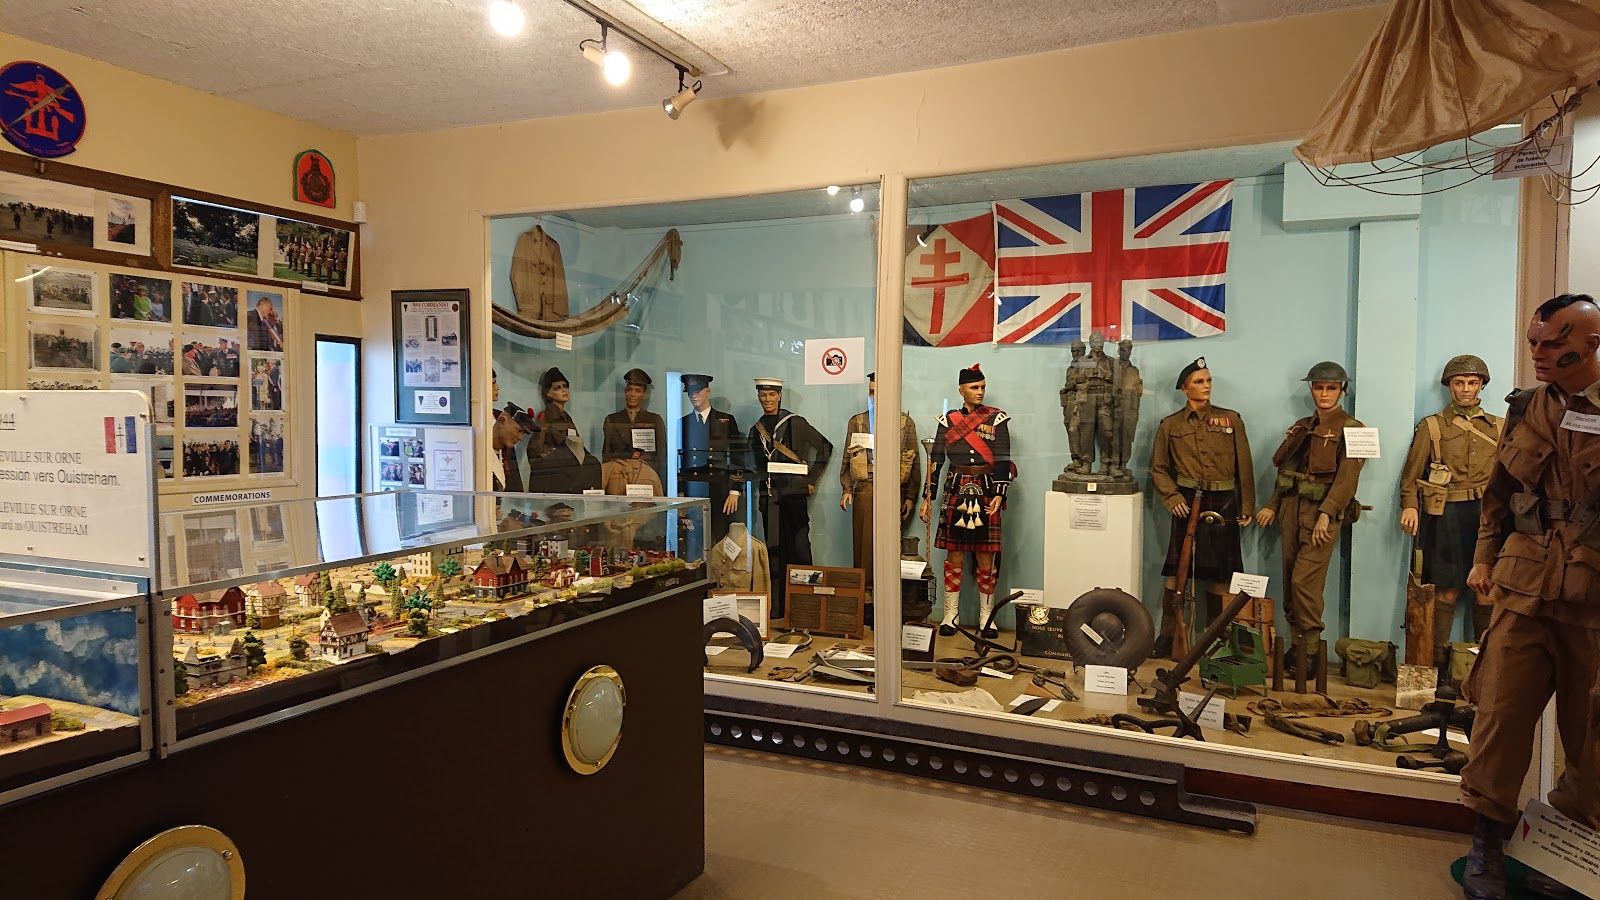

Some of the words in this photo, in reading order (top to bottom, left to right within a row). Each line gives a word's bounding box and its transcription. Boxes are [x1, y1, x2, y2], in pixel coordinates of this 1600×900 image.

[34, 451, 53, 463] SUR
[54, 452, 82, 464] ORNE
[0, 469, 30, 481] ession
[33, 471, 54, 482] vers
[194, 491, 271, 503] COMMEMORATIONS
[39, 504, 57, 516] SUR
[60, 505, 88, 518] ORNE
[24, 520, 88, 536] OUISTREHAM
